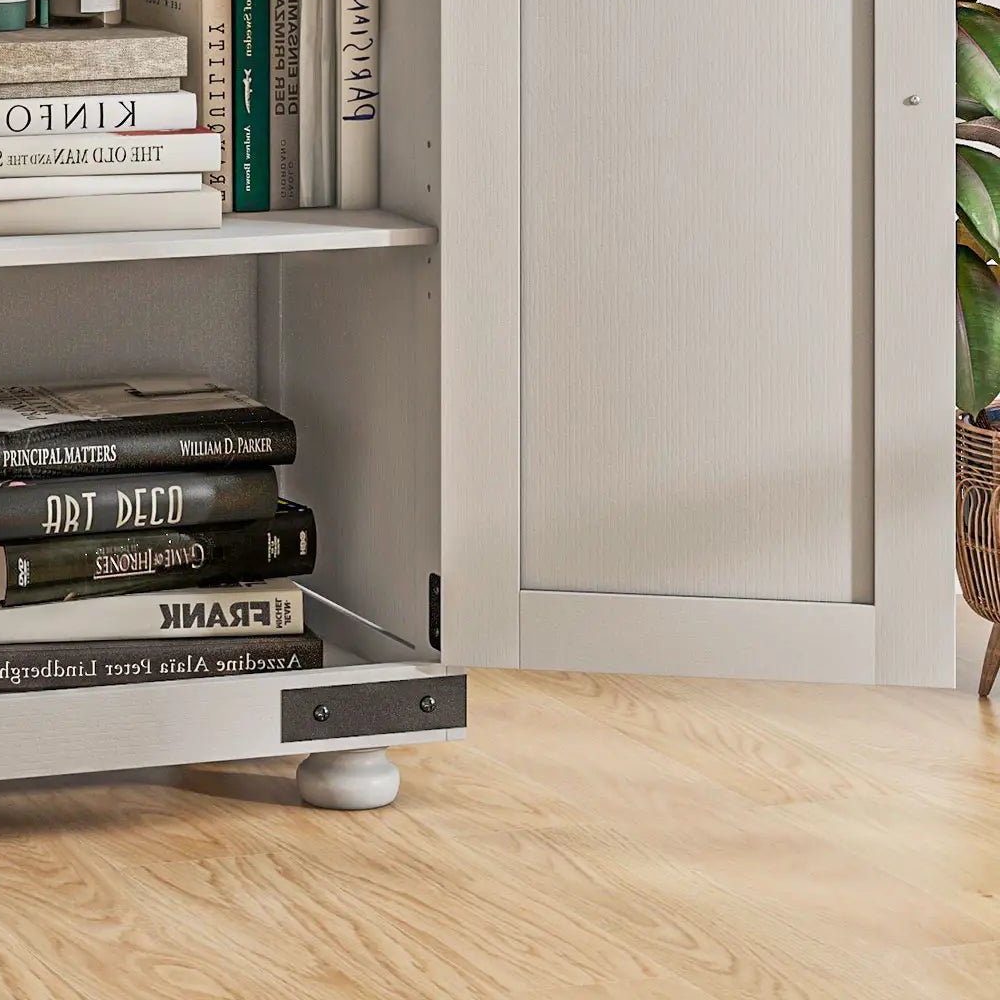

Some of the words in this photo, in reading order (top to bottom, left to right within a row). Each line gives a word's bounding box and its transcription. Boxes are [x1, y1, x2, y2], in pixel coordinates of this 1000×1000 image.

[3, 447, 63, 467] PRINCIPAL
[64, 444, 117, 464] MATTERS
[180, 439, 222, 457] WILLIAM
[225, 438, 235, 455] D.
[238, 437, 273, 453] PARKER
[41, 492, 97, 534] ART
[116, 485, 183, 529] DECO
[93, 549, 156, 580] THRONES
[164, 543, 205, 569] GAME
